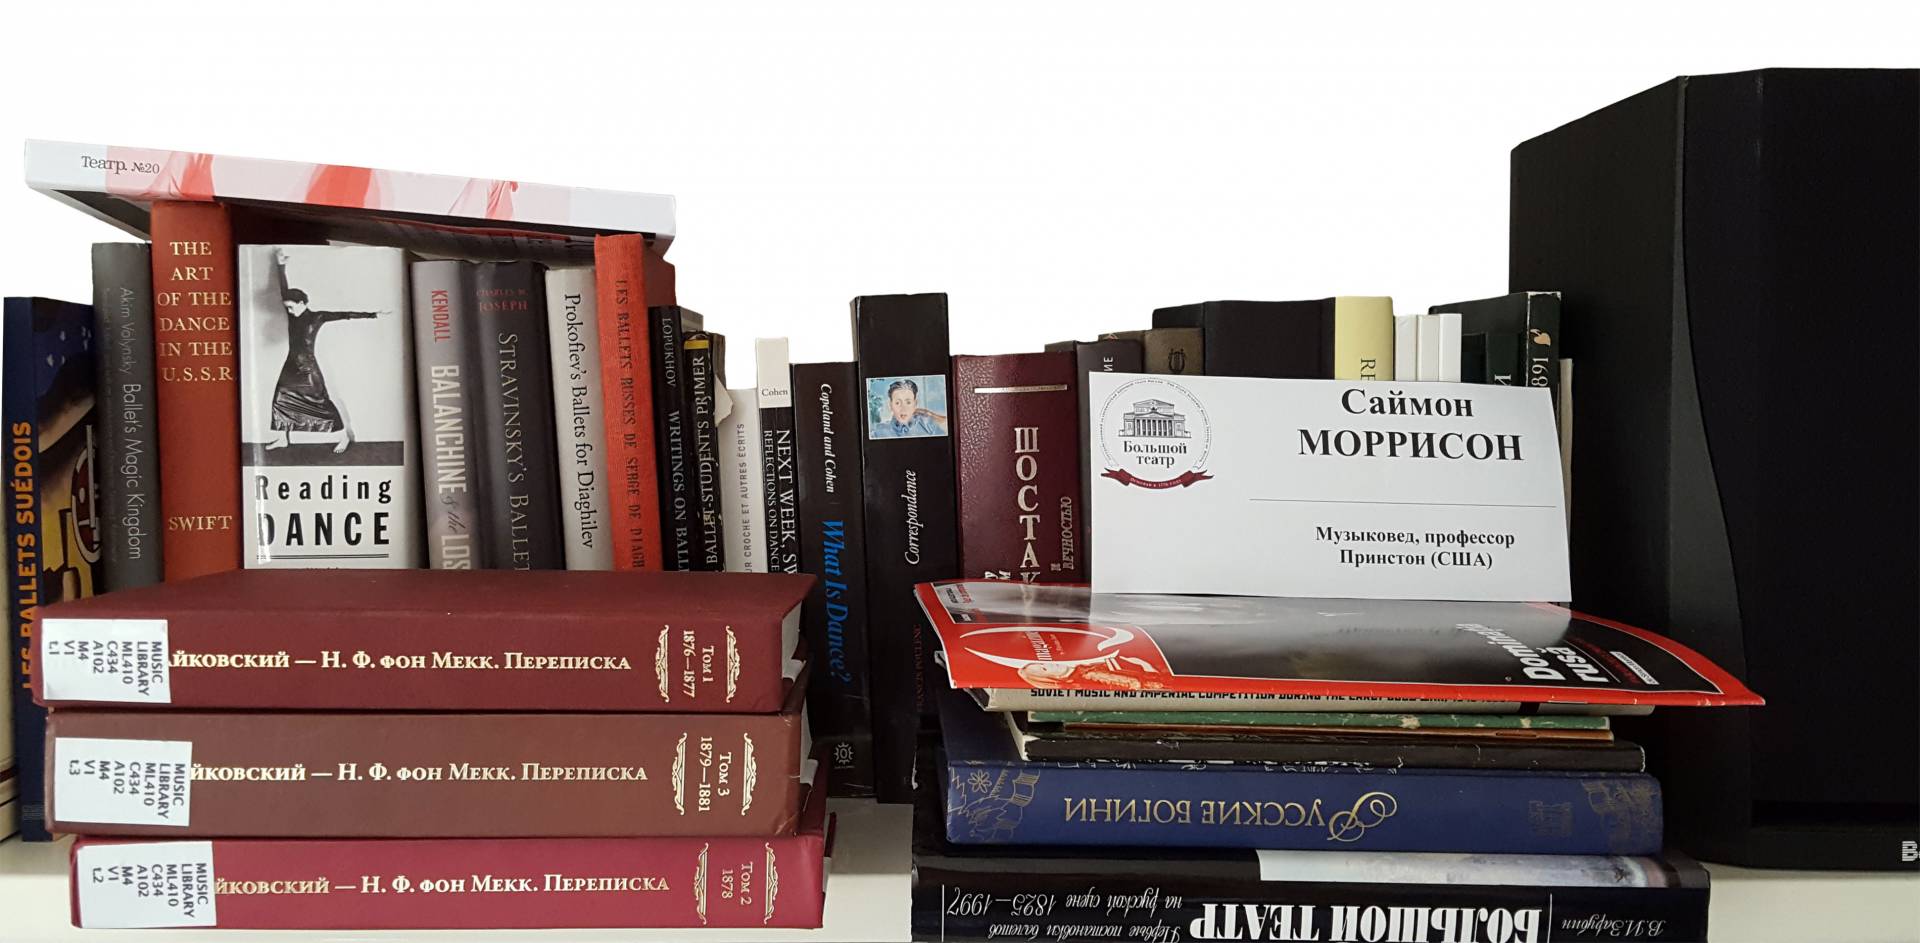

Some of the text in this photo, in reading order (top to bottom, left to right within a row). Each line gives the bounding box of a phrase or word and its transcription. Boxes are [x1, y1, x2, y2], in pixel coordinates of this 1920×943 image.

[81, 155, 160, 175] Театр. №20
[170, 241, 212, 256] THE
[171, 267, 214, 281] ART
[120, 287, 136, 318] Akim
[157, 292, 232, 306] OF THE
[159, 317, 230, 331] DANCE
[431, 290, 451, 344] KENDALL
[160, 342, 233, 357] IN THE
[662, 318, 676, 388] LOPUKHOV
[692, 356, 711, 414] PRIMER
[761, 387, 788, 397] Cohen
[123, 384, 144, 434] Ballet's
[498, 333, 528, 484] STRAVINSKY'S
[1341, 387, 1473, 418] Саймон
[431, 365, 467, 494] BALANCHINE
[564, 293, 598, 549] Prokofiev's Ballets for Diaghilev
[623, 433, 637, 448] DE
[820, 383, 835, 493] Copeland and Cohen
[1123, 440, 1187, 454] Большой
[1298, 428, 1524, 461] МОРРИСОН
[10, 421, 35, 525] SUÉDOIS
[121, 438, 144, 488] Magic
[777, 429, 793, 484] NEXT
[1136, 455, 1175, 468] театр
[255, 475, 392, 504] Reading
[668, 410, 689, 572] WRITINGS ON BALL
[740, 463, 749, 499] AUTRES
[741, 504, 749, 514] ET
[763, 430, 780, 572] REFLECTIONS ON DANCE
[904, 469, 923, 566] Correspondance
[122, 494, 147, 560] Kingdom
[167, 516, 232, 531] SWIFT
[258, 512, 390, 546] DANCE
[779, 489, 796, 549] WEEK,
[1060, 496, 1074, 571] ВЕЧНОСТЬЮ
[743, 518, 752, 558] CROCHE
[1316, 526, 1515, 549] Музыковед, профессор
[1340, 548, 1494, 570] Принстон (США)
[821, 520, 851, 683] What Is Dance?
[64, 640, 75, 655] V1
[78, 641, 89, 660] M4
[93, 640, 104, 674] A102
[107, 640, 118, 674] C434
[122, 641, 134, 685] ML410
[151, 641, 163, 683] MUSIC
[321, 650, 347, 668] Н.
[352, 650, 376, 669] Ф.
[137, 641, 150, 696] LIBRARY
[84, 760, 95, 774] V1
[99, 760, 110, 780] M4
[113, 760, 125, 794] A102
[129, 762, 141, 795] C434
[338, 763, 362, 780] Н.
[368, 763, 392, 780] Ф.
[144, 762, 156, 806] ML410
[157, 763, 171, 819] LIBRARY
[173, 763, 186, 806] MUSIC
[718, 787, 730, 797] 3
[1064, 797, 1192, 824] БОГИНИ
[108, 866, 119, 881] V1
[121, 866, 133, 886] M4
[137, 865, 149, 897] A102
[151, 864, 164, 897] C434
[166, 864, 179, 907] ML410
[196, 863, 209, 905] MUSIC
[360, 875, 386, 893] Н.
[392, 875, 415, 893] Ф.
[721, 869, 734, 899] 1878
[181, 863, 195, 918] LIBRARY
[740, 896, 752, 905] 2
[1066, 886, 1101, 908] сцене
[1106, 887, 1160, 918] русской
[1165, 896, 1183, 908] на
[988, 918, 1182, 943] Первые постановки балетов
[1188, 903, 1321, 941] ТЕАТР
